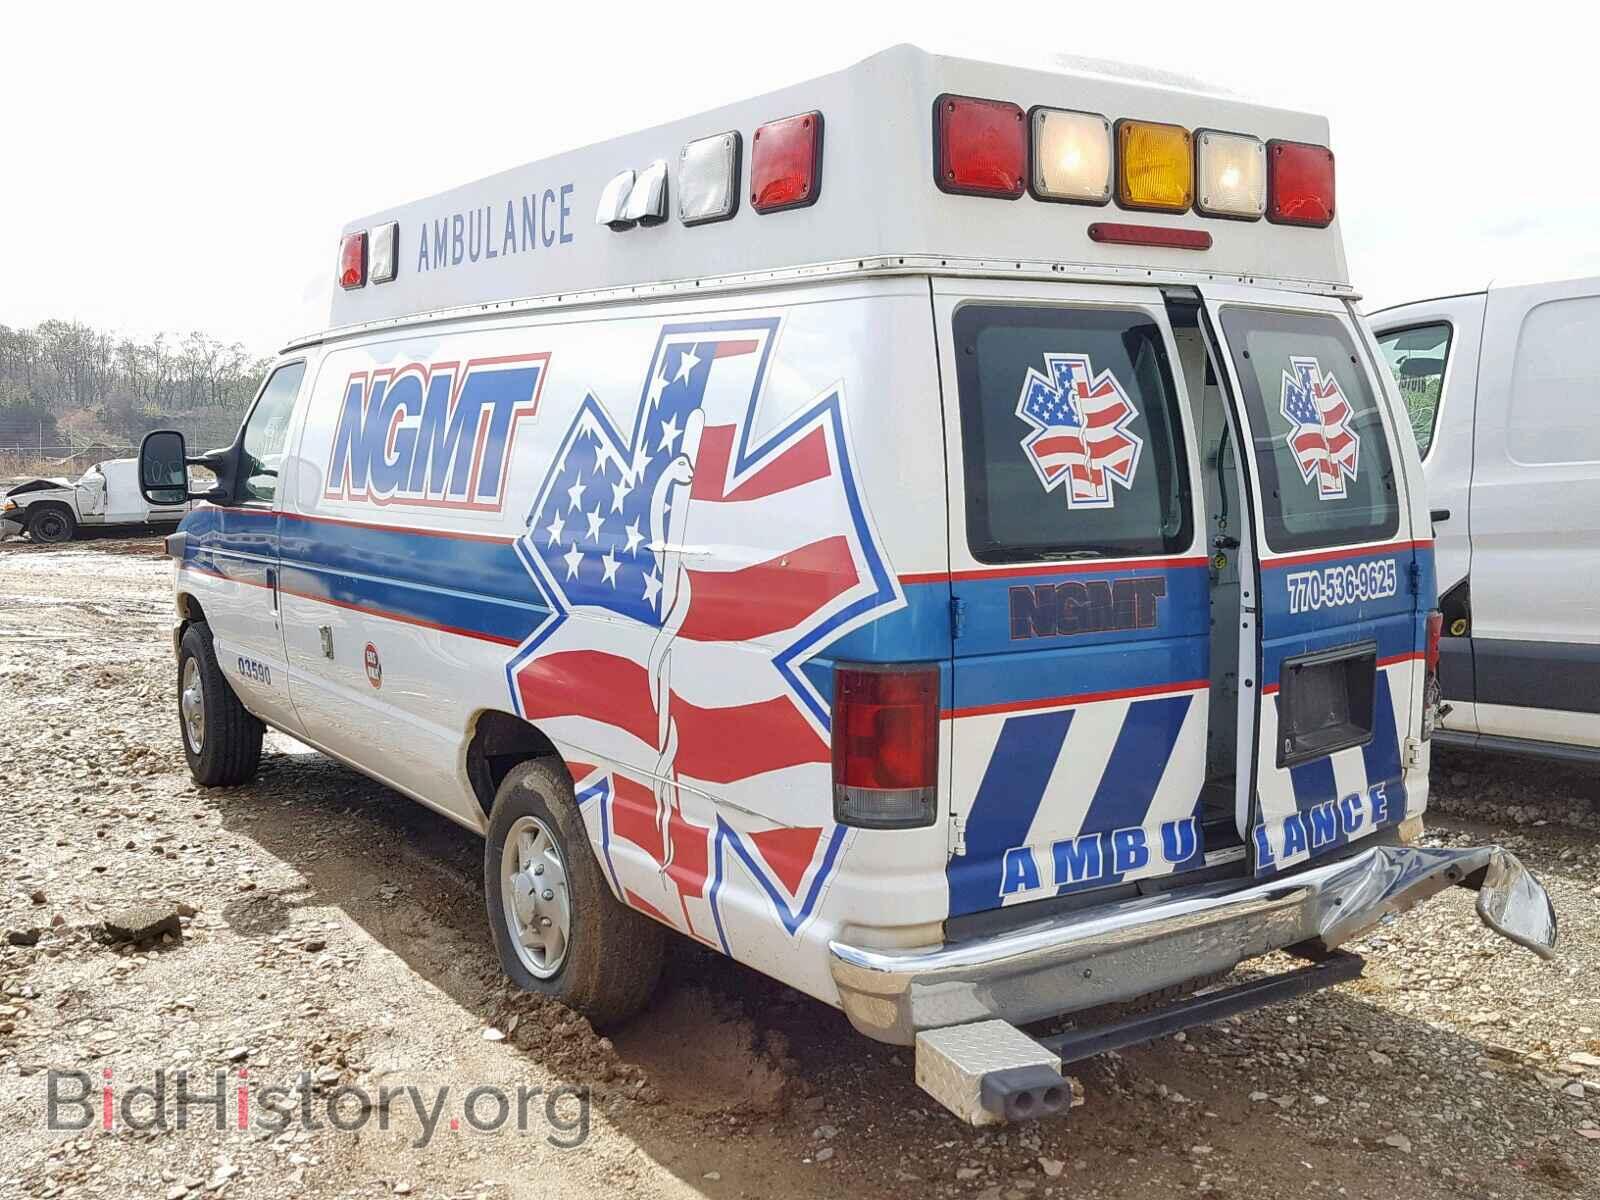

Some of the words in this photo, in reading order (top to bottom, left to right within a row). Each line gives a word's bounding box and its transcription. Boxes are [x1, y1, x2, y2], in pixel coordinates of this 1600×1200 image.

[417, 183, 574, 273] AMBULANCE
[325, 352, 551, 512] NGMT
[1009, 576, 1168, 640] NGMT
[1287, 559, 1396, 614] 770-536-9625
[237, 657, 272, 686] 03590
